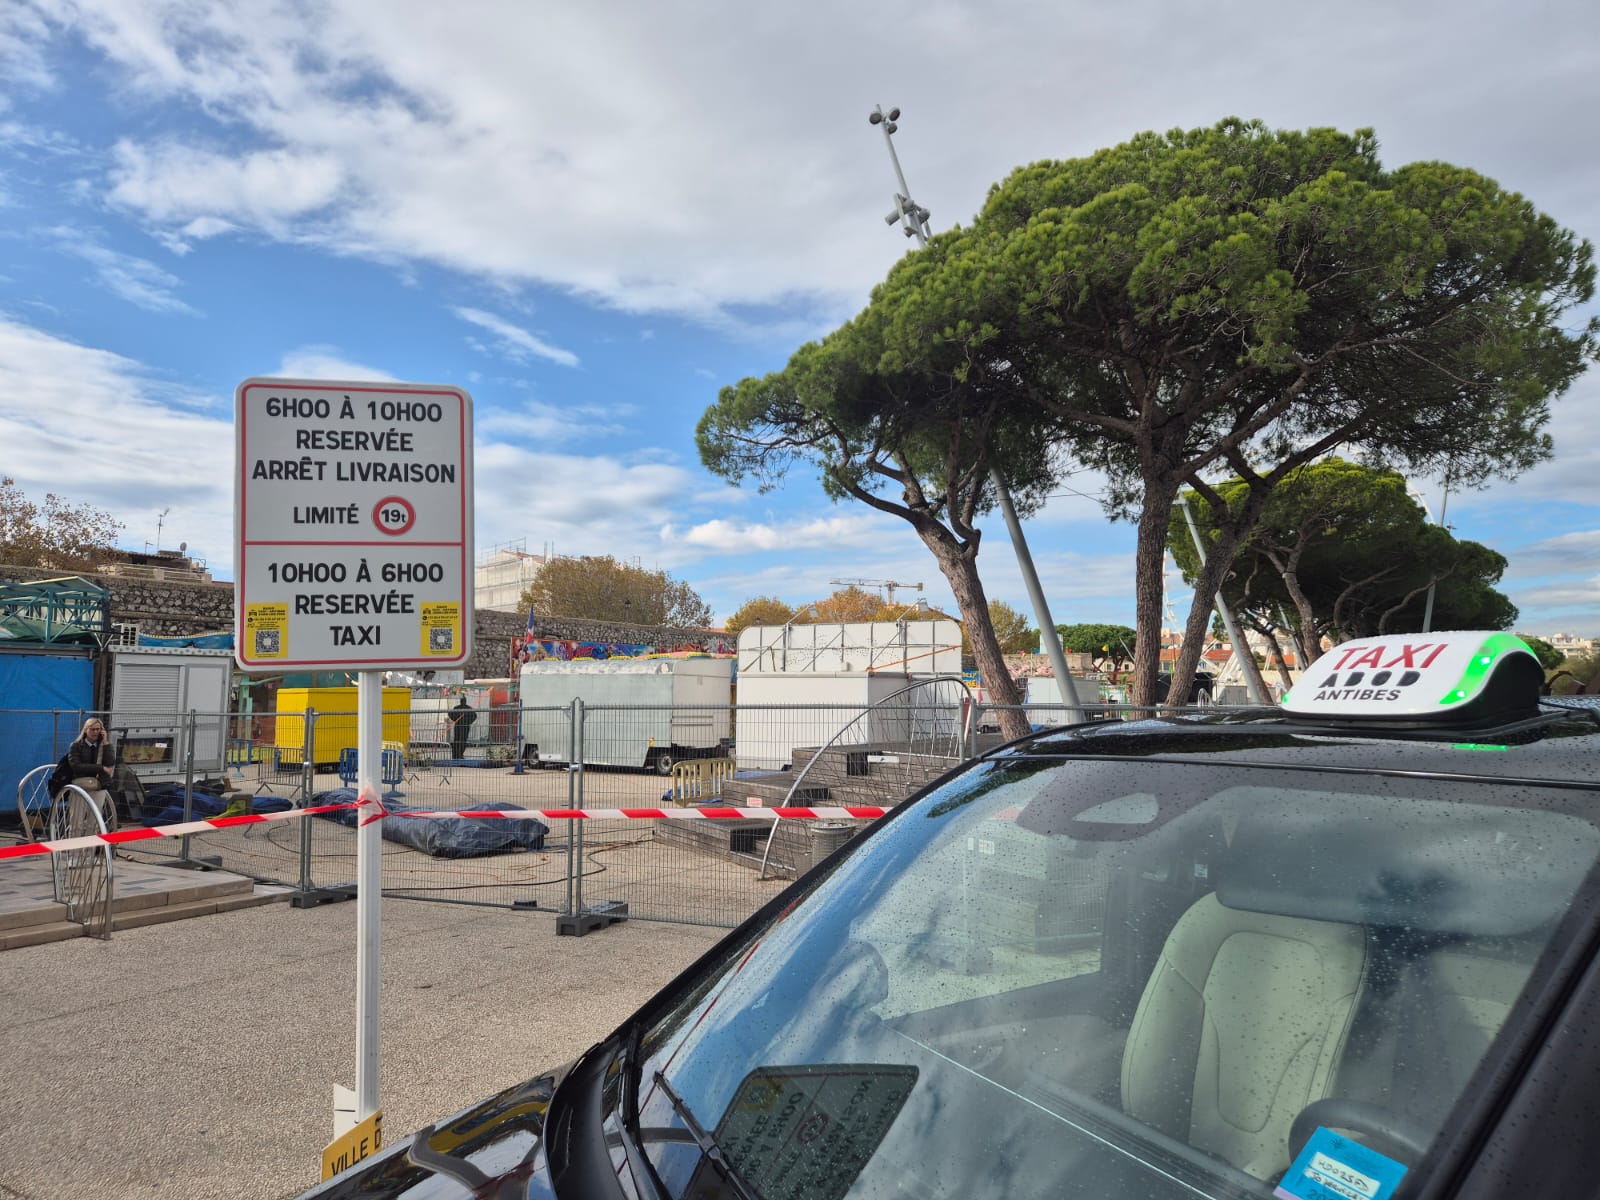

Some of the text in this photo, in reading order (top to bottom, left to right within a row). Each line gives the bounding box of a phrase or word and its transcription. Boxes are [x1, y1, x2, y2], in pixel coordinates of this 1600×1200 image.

[265, 395, 442, 423] 6H00 À 10H00
[296, 428, 414, 452] RESERVÉE
[251, 456, 455, 484] ARRÊT LIVRAISON
[293, 503, 406, 524] LIMITÉ 19t
[267, 558, 444, 584] 10H00 À 6H00
[295, 590, 415, 615] RESERVÉE
[330, 625, 381, 646] TAXI
[1332, 643, 1449, 671] TAXI
[1313, 689, 1402, 701] ANTIBES
[331, 1137, 368, 1177] VILLE
